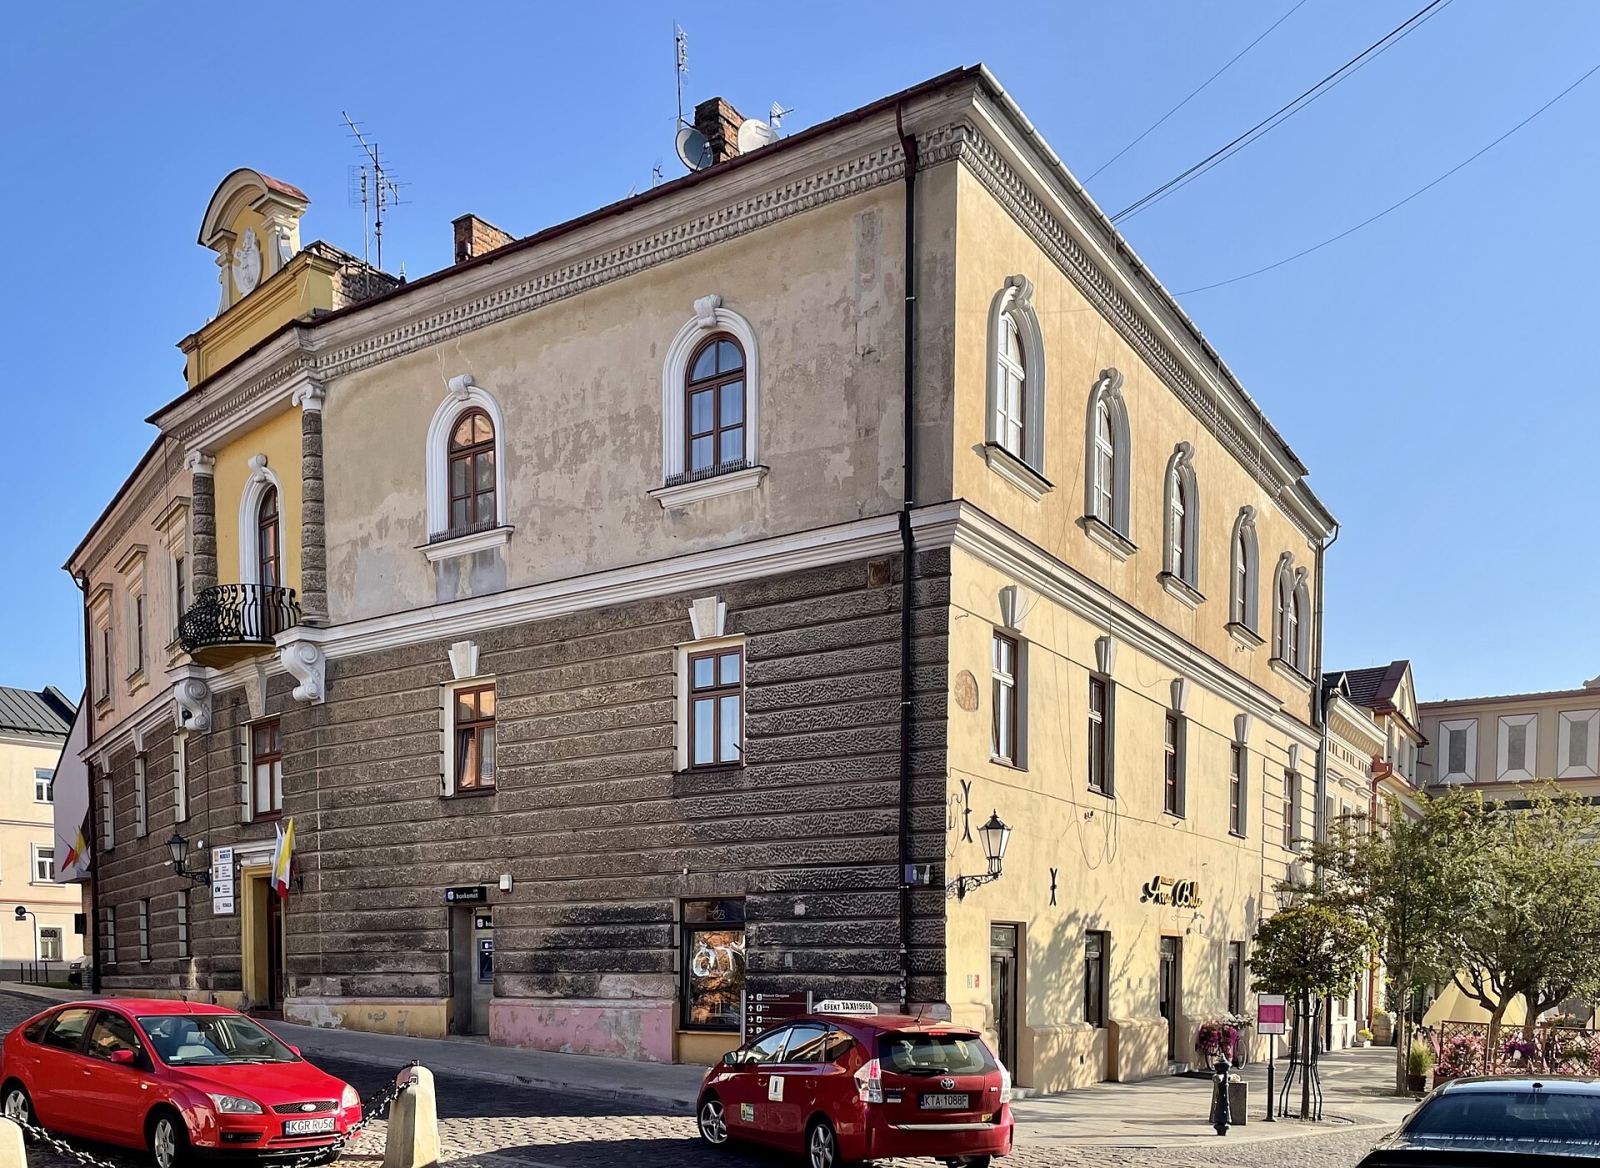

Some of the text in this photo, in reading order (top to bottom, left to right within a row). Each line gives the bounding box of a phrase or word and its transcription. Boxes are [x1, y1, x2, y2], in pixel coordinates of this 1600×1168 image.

[456, 892, 478, 900] bankomat
[824, 1003, 840, 1011] EFEKT
[841, 1002, 856, 1010] TAXI
[925, 1095, 967, 1106] KTA 1088F
[291, 1119, 333, 1132] KGR RU56
